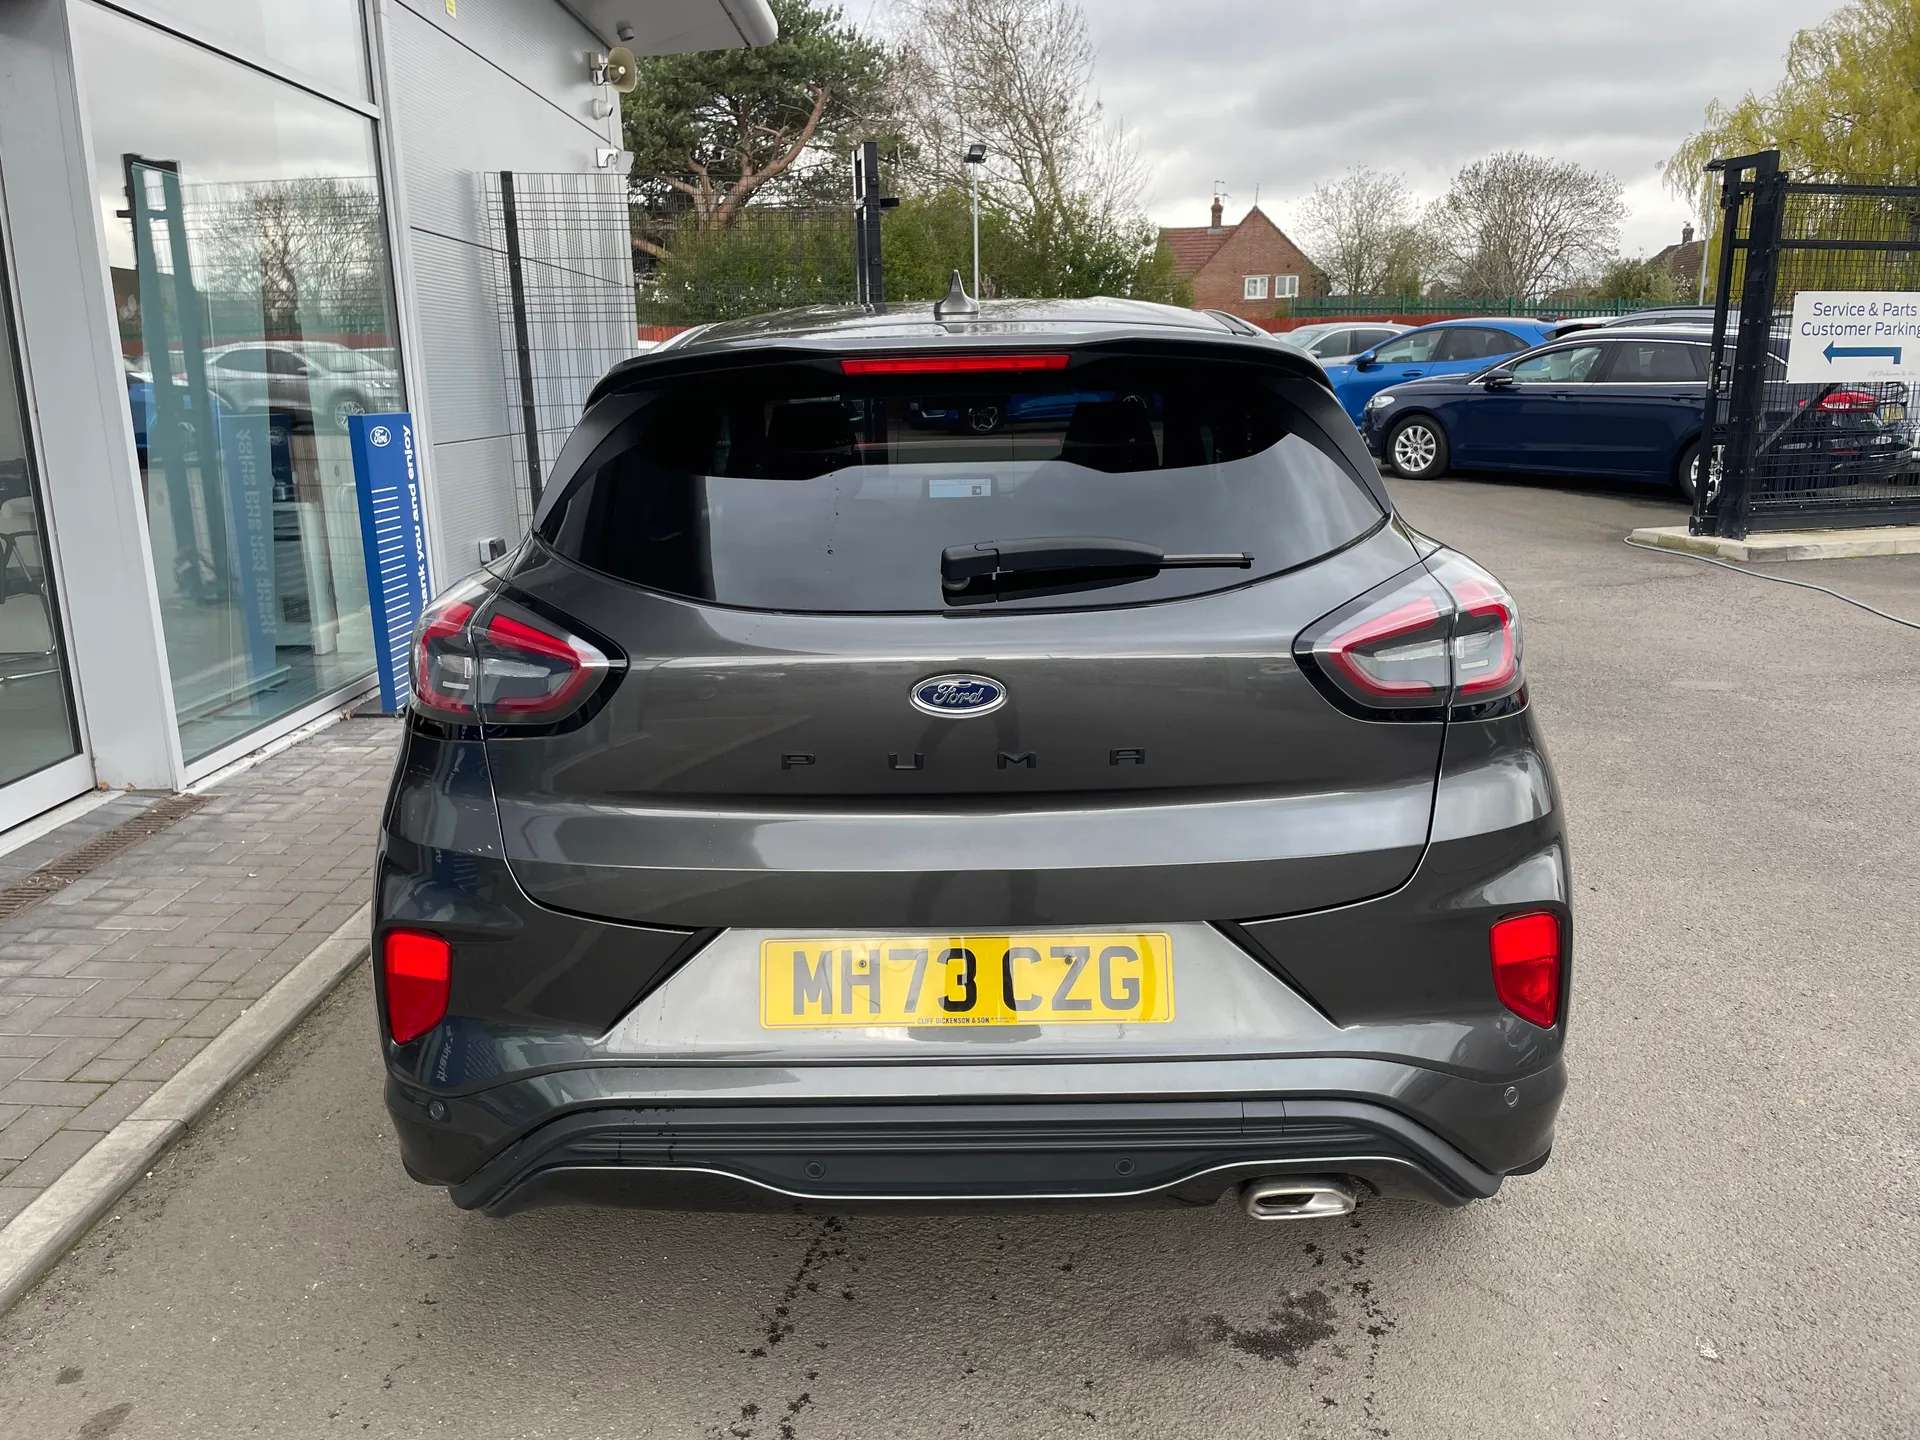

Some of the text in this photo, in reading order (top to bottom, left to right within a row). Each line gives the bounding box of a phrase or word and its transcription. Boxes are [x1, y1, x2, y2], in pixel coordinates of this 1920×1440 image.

[1813, 302, 1917, 317] Service & Parts
[1801, 322, 1871, 336] Customer
[402, 425, 428, 611] hank you and enjoy
[932, 682, 985, 706] Ford
[781, 748, 1145, 770] PUMA
[793, 945, 1140, 1015] MH73 CZG
